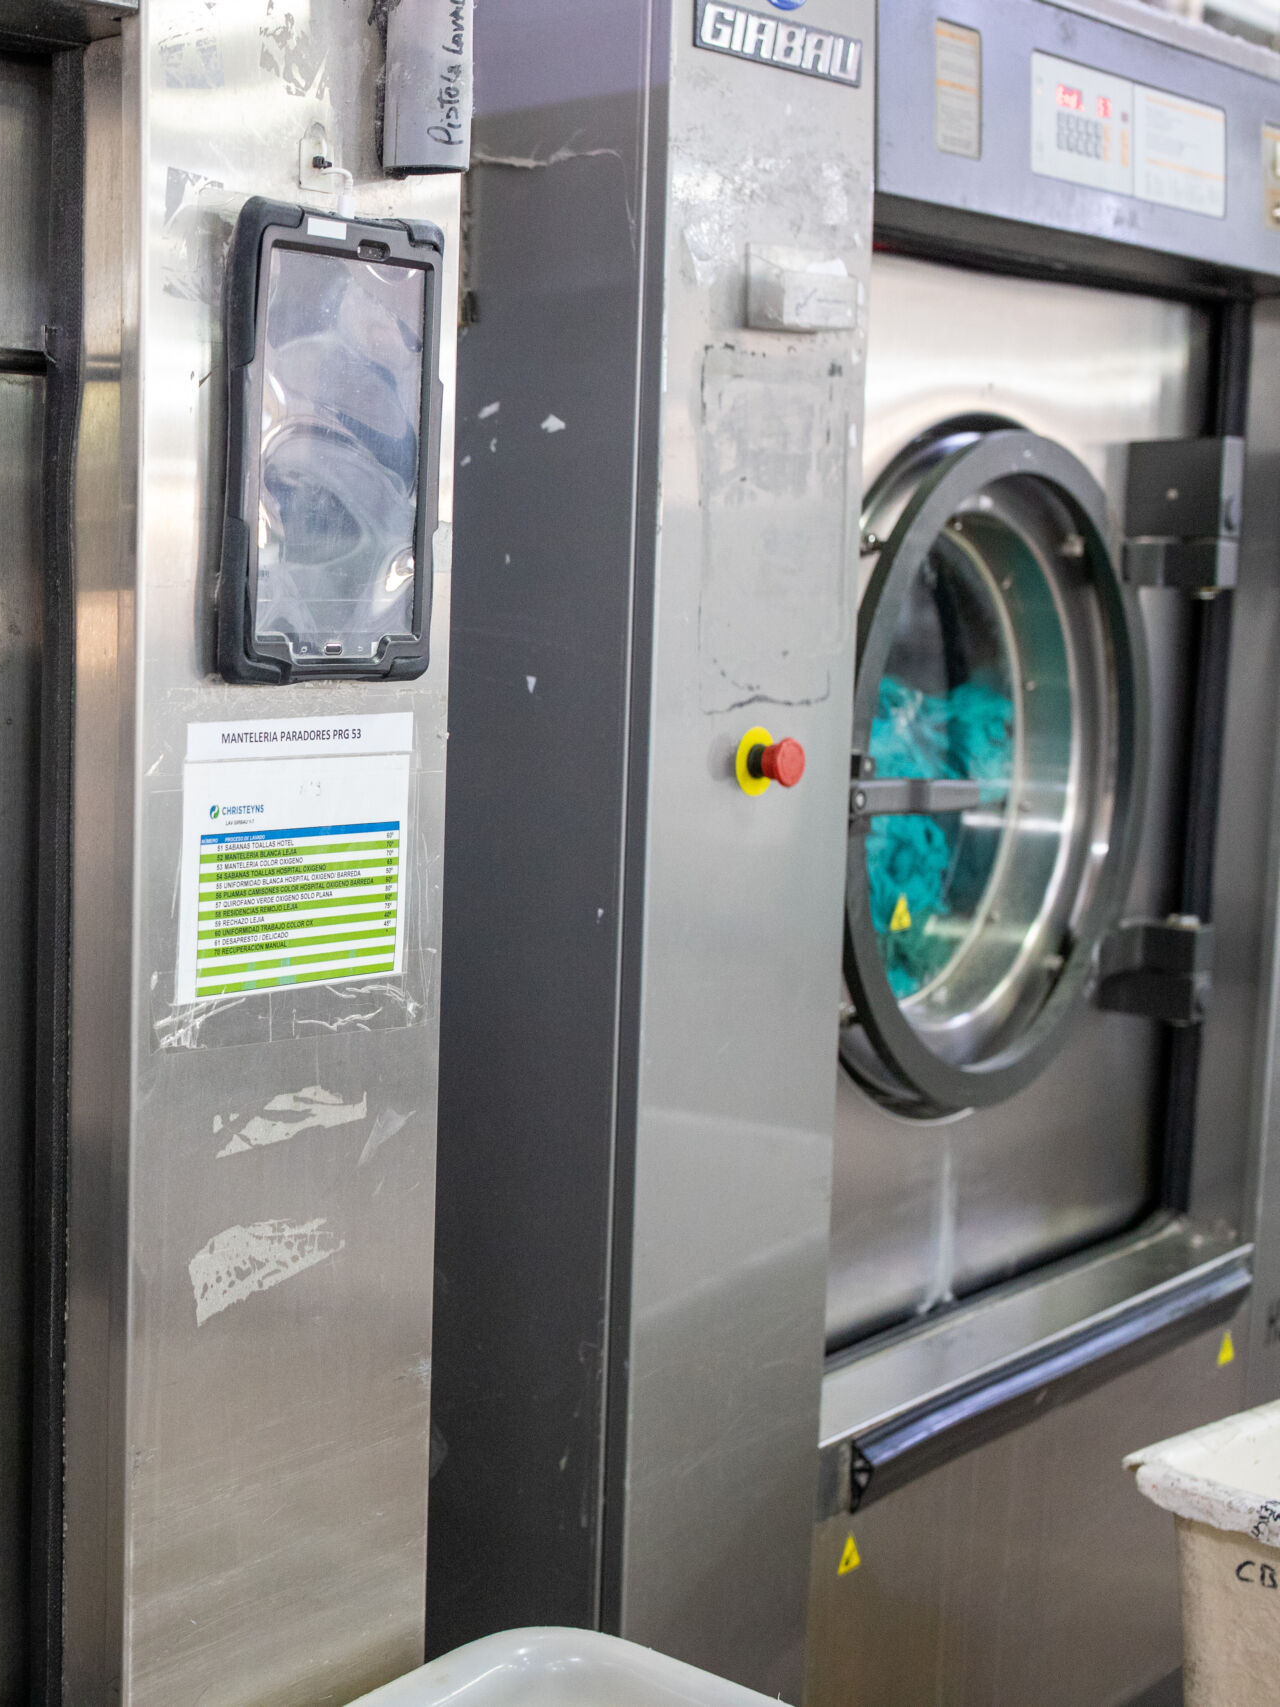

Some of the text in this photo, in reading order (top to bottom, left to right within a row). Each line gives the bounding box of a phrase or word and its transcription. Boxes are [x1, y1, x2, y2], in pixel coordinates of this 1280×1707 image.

[221, 728, 362, 744] MANTELERIA PARADORES PRG 53
[222, 804, 264, 815] CHRISTEYNS
[224, 843, 250, 851] SABANAS
[252, 841, 276, 849] TOALLAS
[224, 852, 259, 860] MANTELERIA
[224, 861, 258, 870] MANTELERIA
[260, 859, 279, 867] COLOR
[280, 857, 304, 865] OXIGENO
[223, 879, 261, 889] UNIFORMIDAD
[262, 877, 283, 885] BLANCA
[285, 874, 310, 883] HOSPITAL
[337, 870, 361, 878] BARREDA
[224, 871, 250, 879] SABANAS
[251, 869, 275, 877] TOALLAS
[276, 867, 301, 875] HOSPITAL
[248, 887, 279, 895] CAMISONES
[280, 884, 299, 892] COLOR
[300, 883, 324, 891] HOSPITAL
[350, 878, 374, 886] BARREDA
[223, 898, 255, 908] QUIROFANO
[256, 896, 274, 904] VERDE
[276, 894, 299, 902] OXIGENO
[300, 892, 315, 900] SOLO
[316, 891, 333, 899] PLANA
[222, 907, 259, 916] RESIDENCIAS
[260, 905, 282, 913] REMOJO
[222, 918, 248, 926] RECHAZO
[250, 916, 265, 924] LEJIA
[222, 926, 259, 936] UNIFORMIDAD
[260, 923, 285, 932] TRABAJO
[286, 920, 305, 929] COLOR
[222, 935, 258, 945] DESAPRESTO
[261, 932, 288, 941] DELICADO
[222, 944, 264, 954] RECUPERACION
[265, 941, 287, 950] MANUAL
